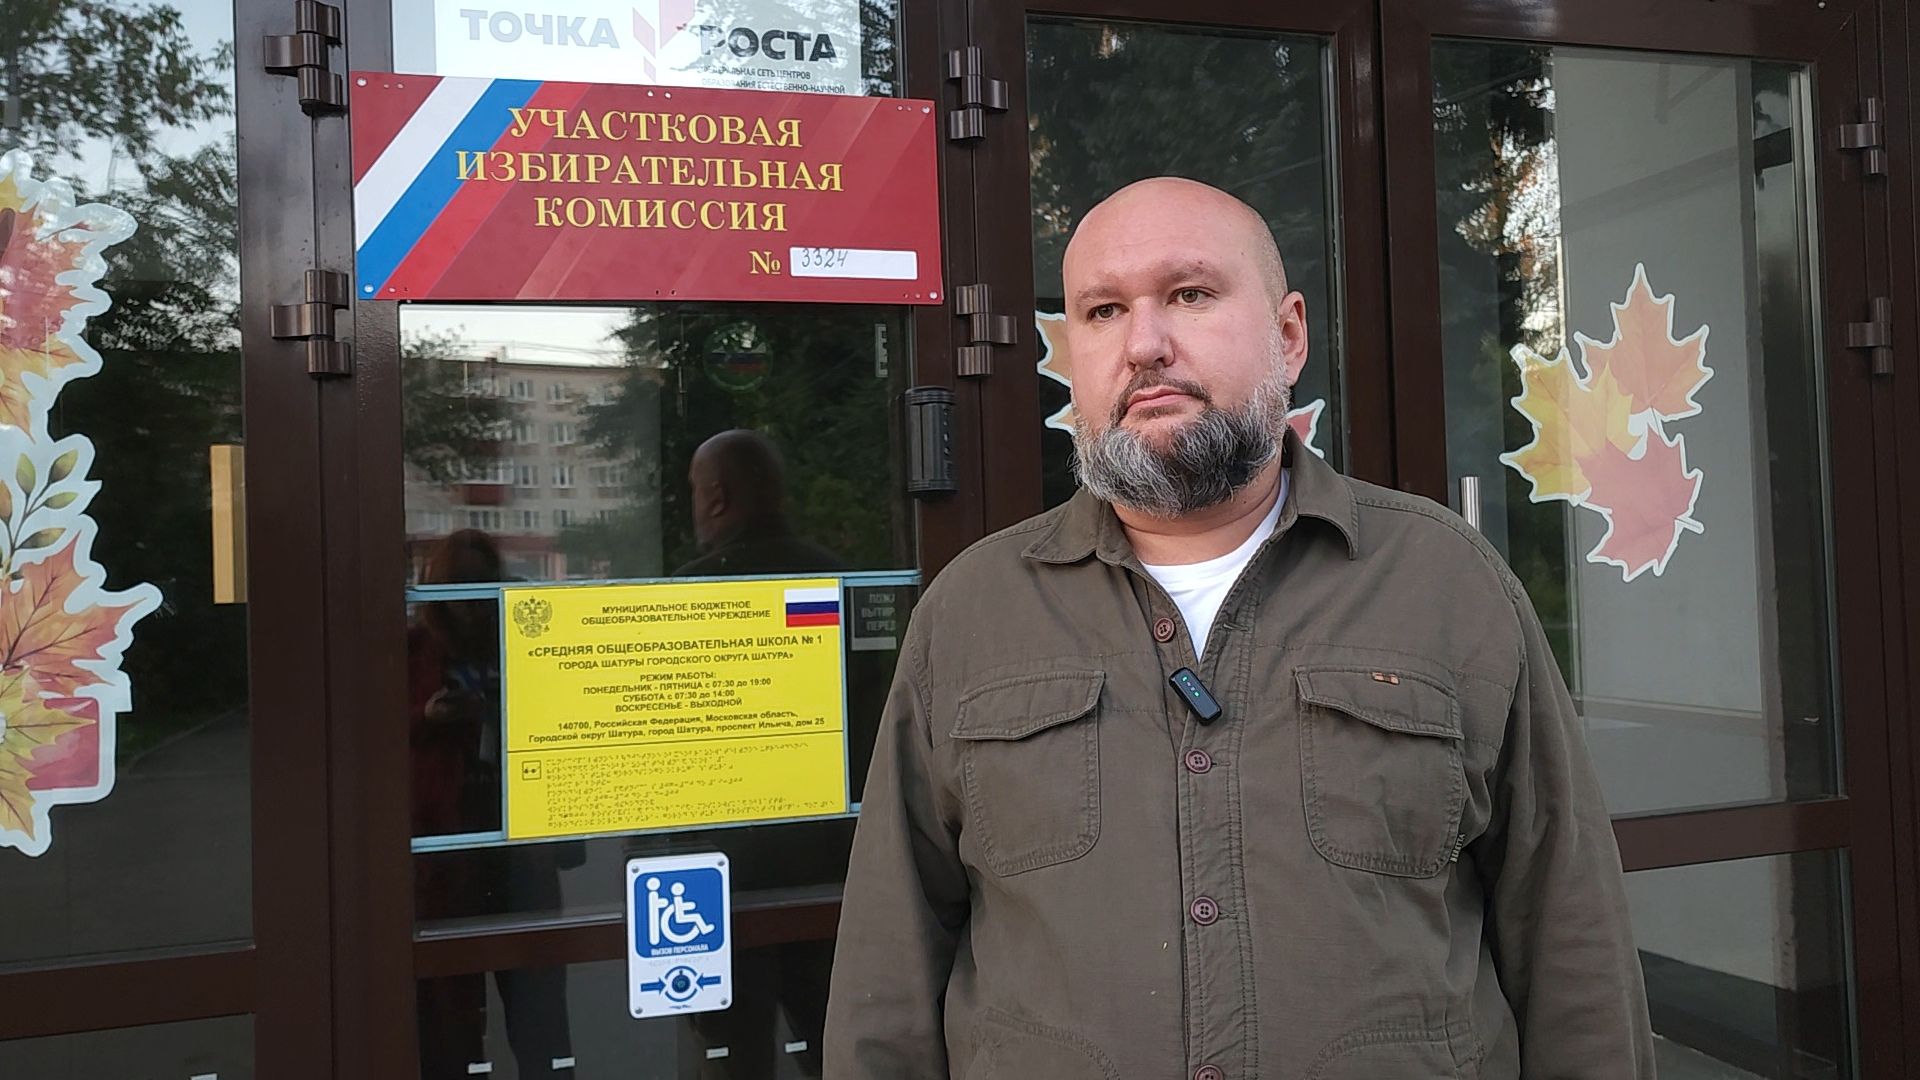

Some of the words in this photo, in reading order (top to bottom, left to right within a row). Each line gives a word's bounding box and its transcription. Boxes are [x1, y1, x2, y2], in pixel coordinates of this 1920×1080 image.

[460, 8, 620, 49] ТОЧКА
[700, 25, 837, 62] РОСТА
[757, 69, 776, 79] СЕТЬ
[776, 71, 811, 80] ЦЕНТРОВ
[508, 107, 803, 148] УЧАСТКОВАЯ
[455, 150, 844, 192] ИЗБИРАТЕЛЬНАЯ
[534, 197, 787, 232] КОМИССИЯ
[749, 250, 781, 275] №
[801, 248, 848, 268] 3324
[602, 603, 688, 614] МУНИЦИПАЛЬНОЕ
[690, 601, 751, 612] БЮДЖЕТНОЕ
[581, 612, 706, 626] ОБЩЕОБРАЗОВАТЕЛЬНОЕ
[708, 610, 771, 621] УЧРЕЖДЕНИЕ
[528, 645, 593, 658] «СРЕДНЯЯ
[597, 638, 753, 655] ОБЩЕОБРАЗОВАТЕЛЬНАЯ
[757, 636, 799, 647] ШКОЛА
[801, 635, 814, 645] №
[817, 635, 822, 644] 1
[558, 661, 599, 671] ГОРОДА
[601, 658, 645, 668] ШАТУРЫ
[647, 655, 712, 666] ГОРОДСКОГО
[713, 653, 750, 663] ОКРУГА
[752, 651, 794, 662] ШАТУРА»
[583, 683, 653, 695] ПОНЕДЕЛЬНИК
[660, 680, 703, 692] ПЯТНИЦА
[712, 679, 735, 688] 07:30
[736, 680, 748, 688] до
[750, 677, 772, 686] 19:00
[640, 673, 674, 682] РЕЖИМ
[676, 671, 717, 680] РАБОТЫ:
[615, 702, 682, 713] ВОСКРЕСЕНЬЕ
[690, 697, 743, 709] ВЫХОДНОЙ
[622, 692, 665, 703] СУББОТА
[674, 690, 697, 700] 07:30
[699, 691, 711, 700] до
[713, 688, 735, 698] 14:00
[528, 733, 578, 744] Городской
[581, 731, 606, 741] округ
[608, 728, 645, 740] Шатура,
[648, 727, 674, 737] город
[676, 724, 714, 735] Шатура,
[716, 722, 756, 733] проспект
[758, 719, 794, 729] Ильича,
[796, 719, 813, 727] дом
[814, 716, 825, 725] 25
[558, 721, 592, 731] 140700,
[594, 718, 648, 729] Российская
[650, 715, 703, 727] Федерация,
[705, 711, 758, 722] Московская
[760, 709, 799, 719] область,
